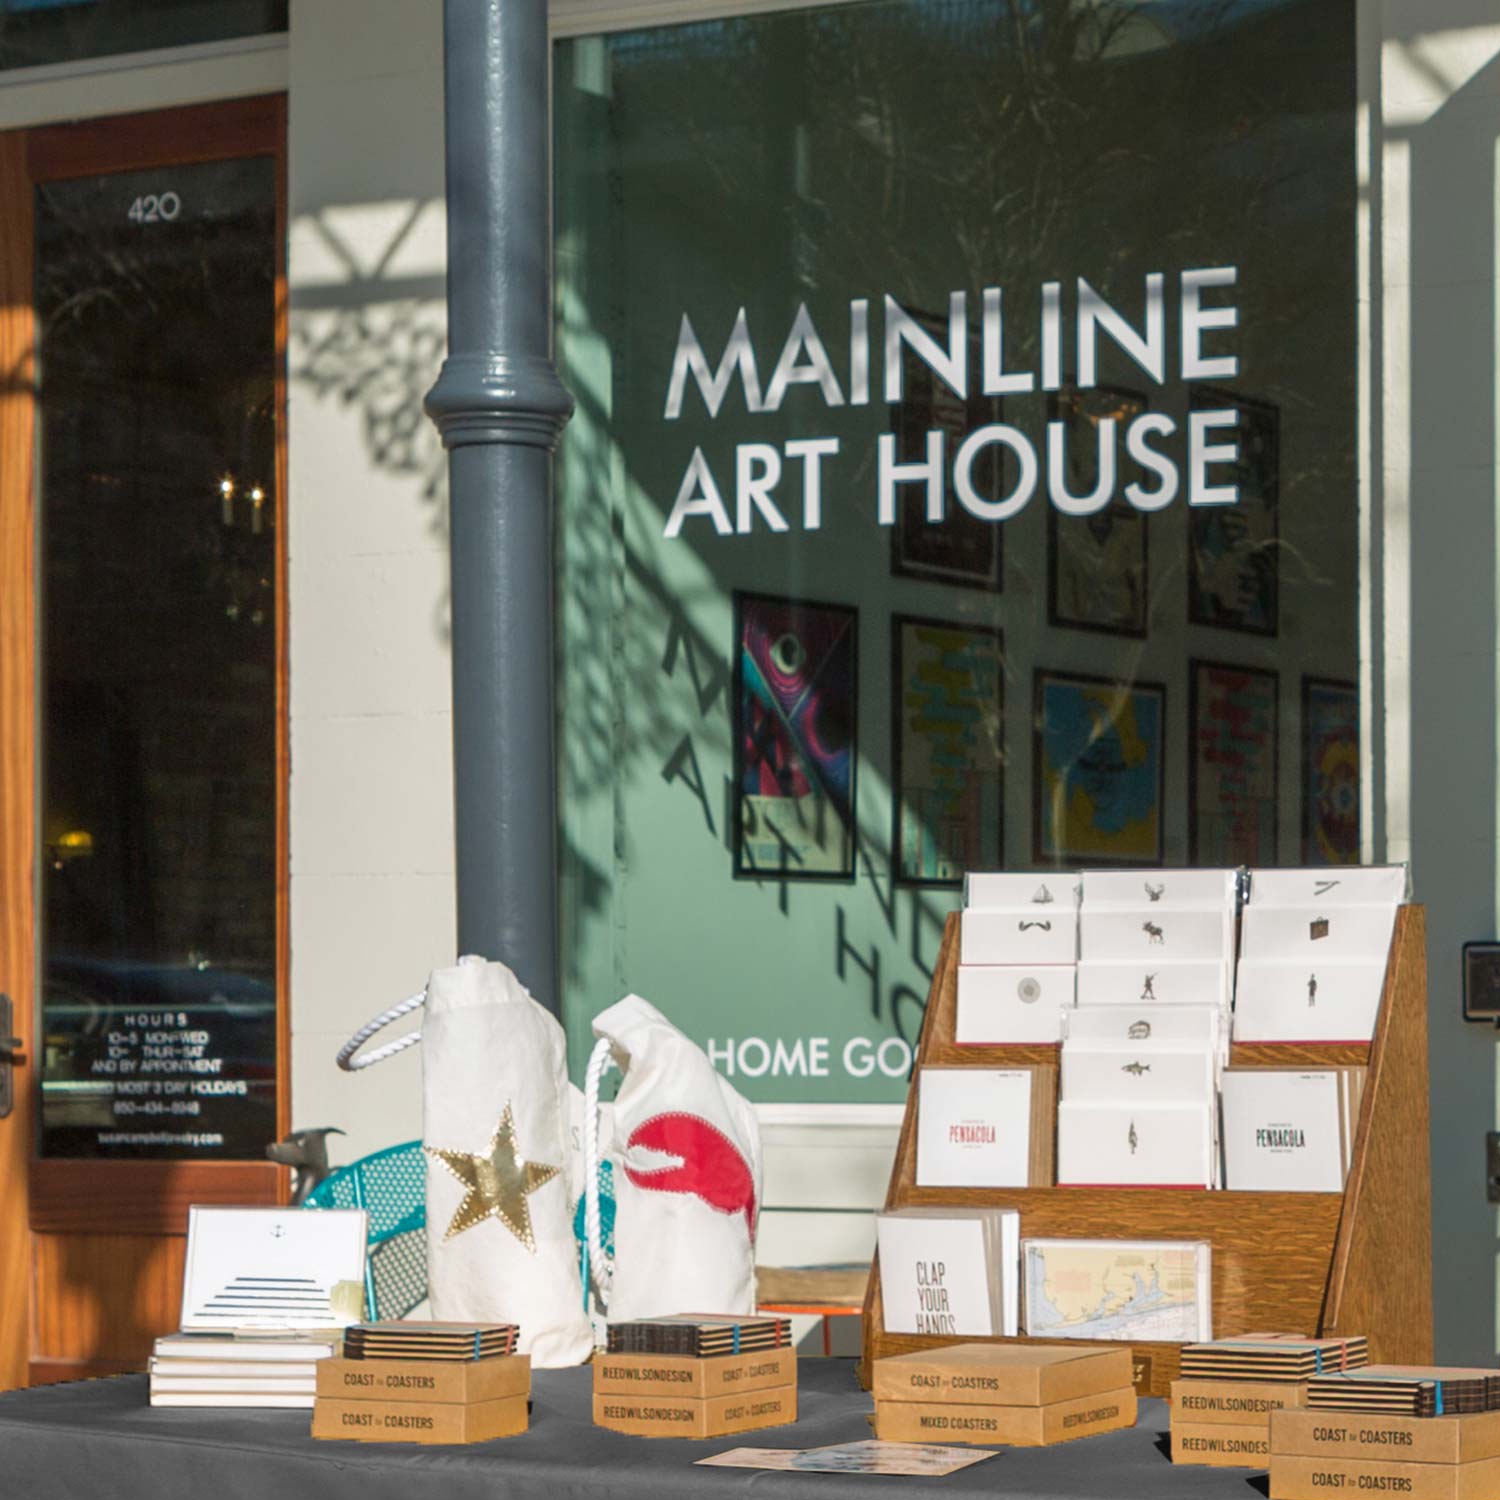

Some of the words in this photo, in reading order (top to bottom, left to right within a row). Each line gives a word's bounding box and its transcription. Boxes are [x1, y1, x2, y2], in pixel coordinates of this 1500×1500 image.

[128, 191, 180, 223] 420
[663, 266, 1238, 420] MAINLINE
[663, 438, 840, 538] ART
[878, 410, 1238, 525] HOUSE
[91, 1059, 117, 1072] AND
[119, 1059, 137, 1072] BY
[140, 1058, 223, 1072] APPOINTMENT
[707, 1037, 830, 1077] HOME
[843, 1037, 919, 1077] GO
[117, 1081, 150, 1095] MOST
[153, 1081, 162, 1095] 3
[164, 1081, 187, 1095] DAY
[190, 1080, 248, 1095] HOLIDAYS
[949, 1126, 996, 1143] PENSACOLA
[1256, 1129, 1306, 1148] PENSACOLA
[916, 1261, 946, 1286] CLAP
[917, 1287, 950, 1312] YOUR
[916, 1313, 956, 1335] HANDS
[344, 1373, 375, 1386] COAST
[386, 1375, 435, 1389] COASTERS
[602, 1366, 693, 1383] REEDWILSONDESIGN
[722, 1368, 743, 1382] COAST
[911, 1374, 940, 1388] COAST
[952, 1376, 999, 1390] COASTERS
[1181, 1395, 1284, 1413] REEDWILSONDESIGN
[342, 1412, 373, 1426] COAST
[384, 1415, 434, 1429] COASTERS
[603, 1405, 695, 1422] REEDWILSONDESIGN
[724, 1406, 745, 1421] COAST
[920, 1415, 949, 1429] MIXED
[950, 1417, 998, 1431] COASTERS
[1313, 1427, 1347, 1442] COAST
[1359, 1429, 1413, 1446] COASTERS
[1312, 1472, 1346, 1488] COAST
[1358, 1475, 1412, 1492] COASTERS
